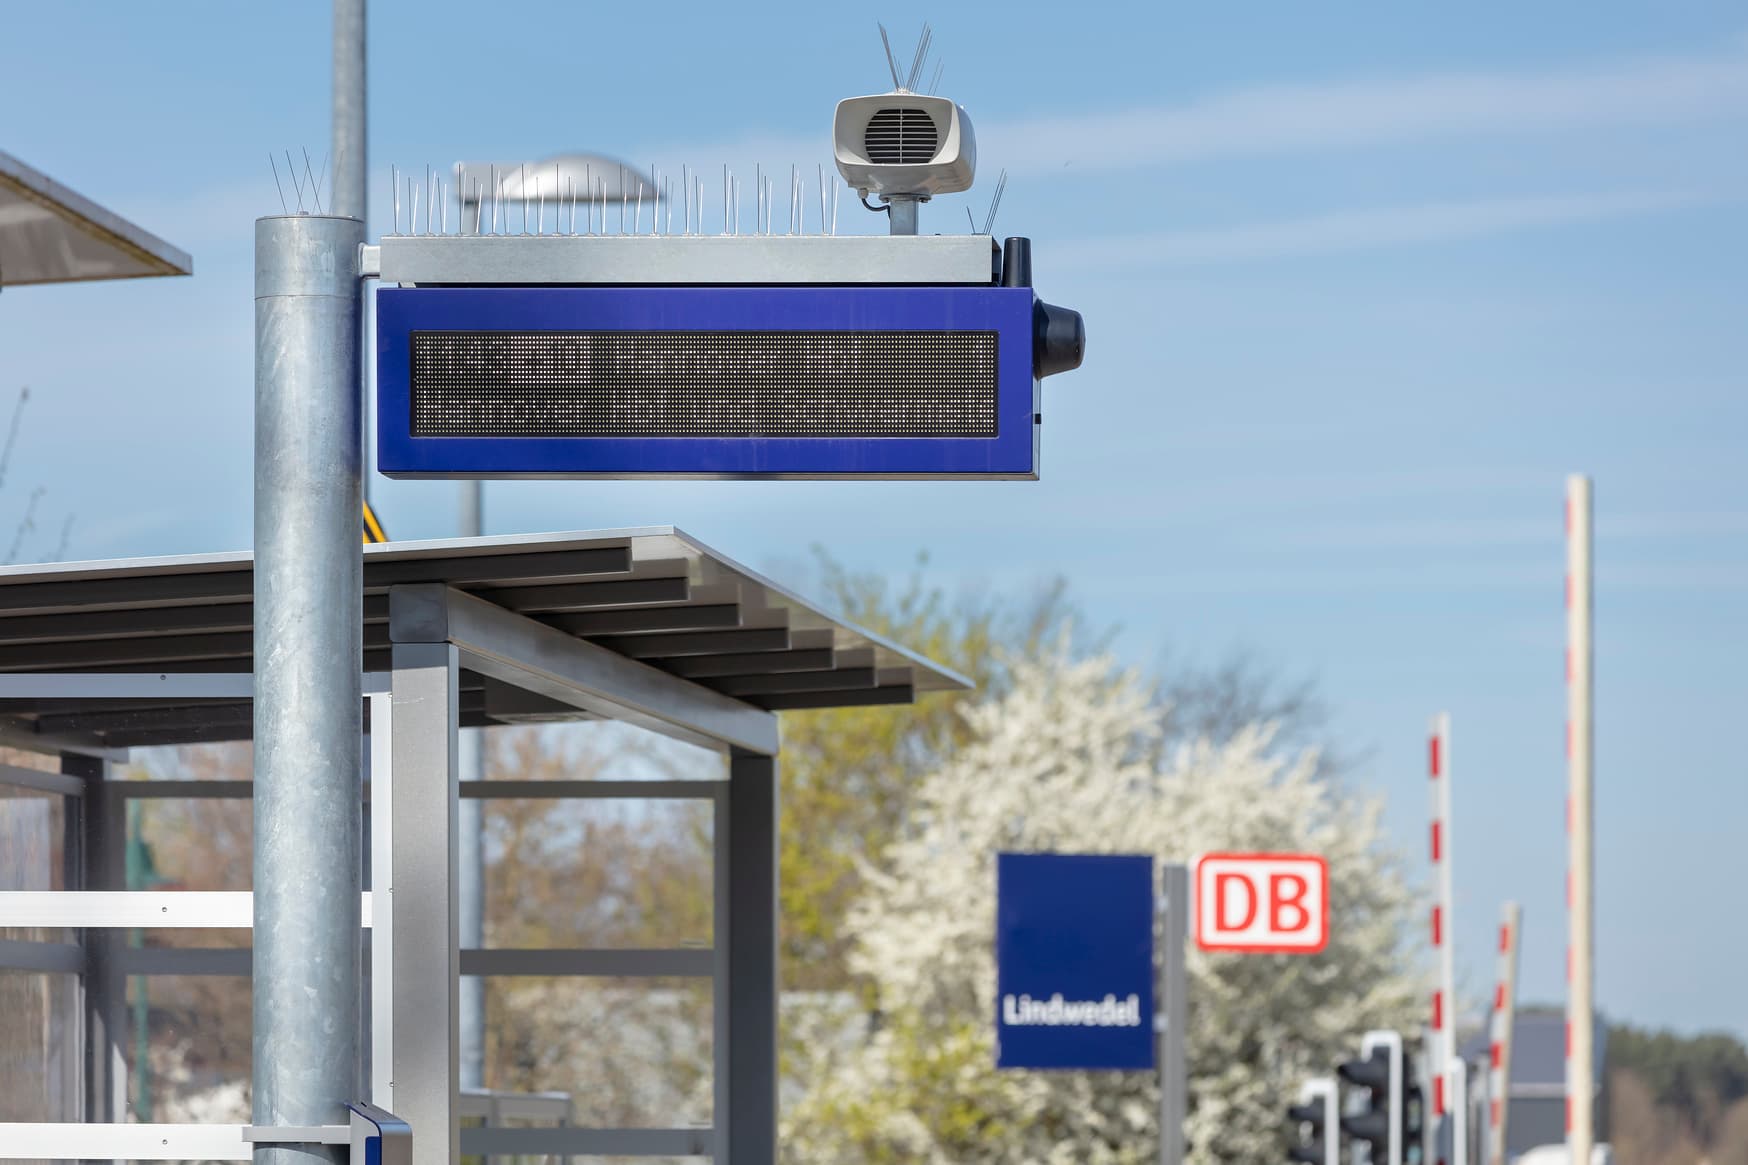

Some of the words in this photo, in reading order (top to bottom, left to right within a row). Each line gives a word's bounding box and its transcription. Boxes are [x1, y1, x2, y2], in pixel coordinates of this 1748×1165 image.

[418, 340, 507, 374] 11:43
[520, 338, 580, 376] +10
[616, 340, 781, 374] Hannover
[806, 340, 862, 374] Hbf
[970, 340, 985, 374] 1
[422, 389, 588, 424] Hannover
[612, 389, 668, 424] Hbf
[692, 389, 757, 424] und
[1215, 873, 1311, 933] DB
[1003, 992, 1141, 1027] Lindwedel
